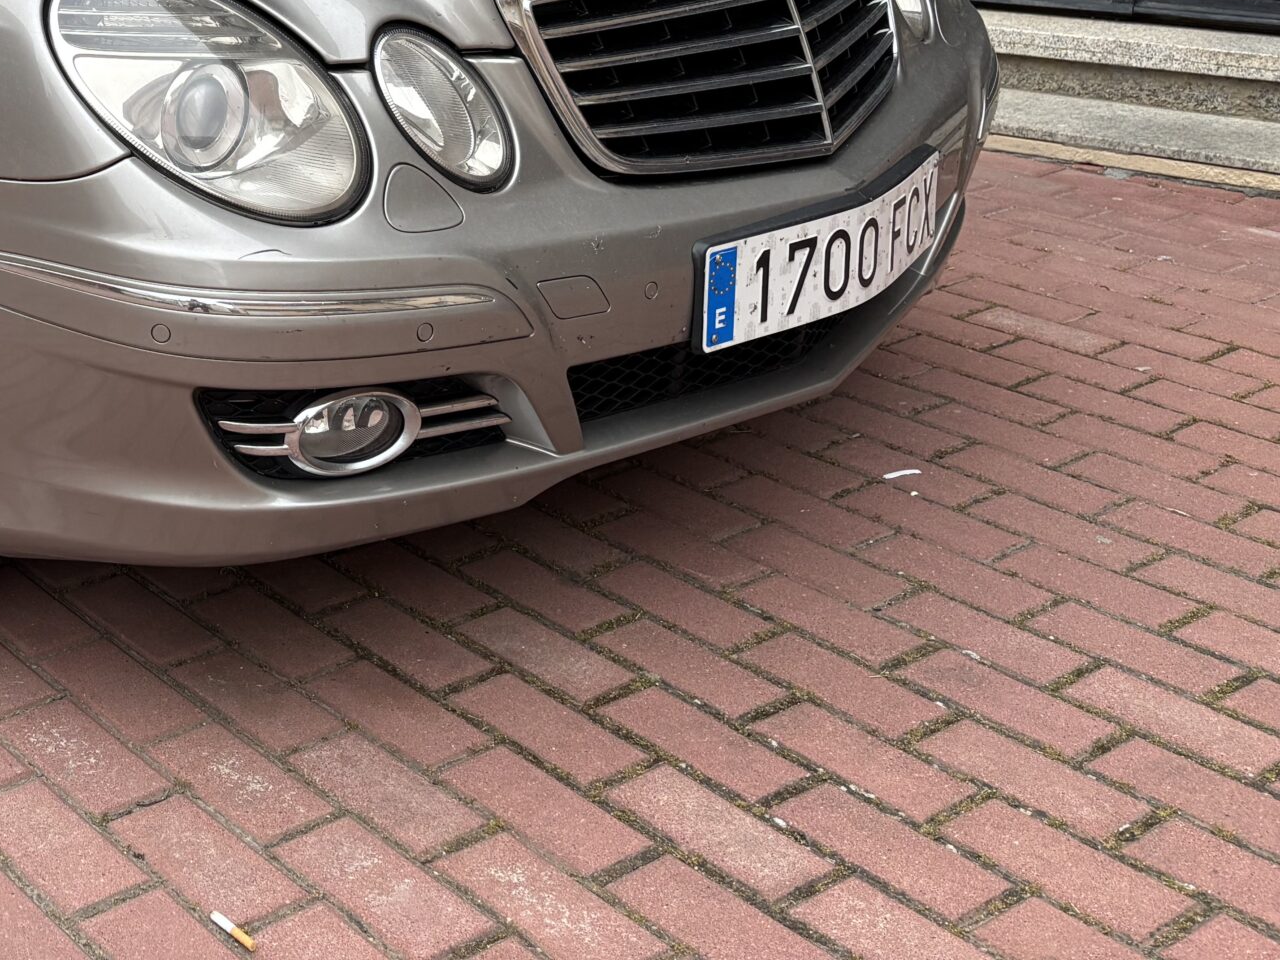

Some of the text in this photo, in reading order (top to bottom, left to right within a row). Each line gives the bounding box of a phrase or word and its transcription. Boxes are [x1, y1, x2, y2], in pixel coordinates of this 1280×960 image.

[715, 169, 937, 329] E 1700 FCX
